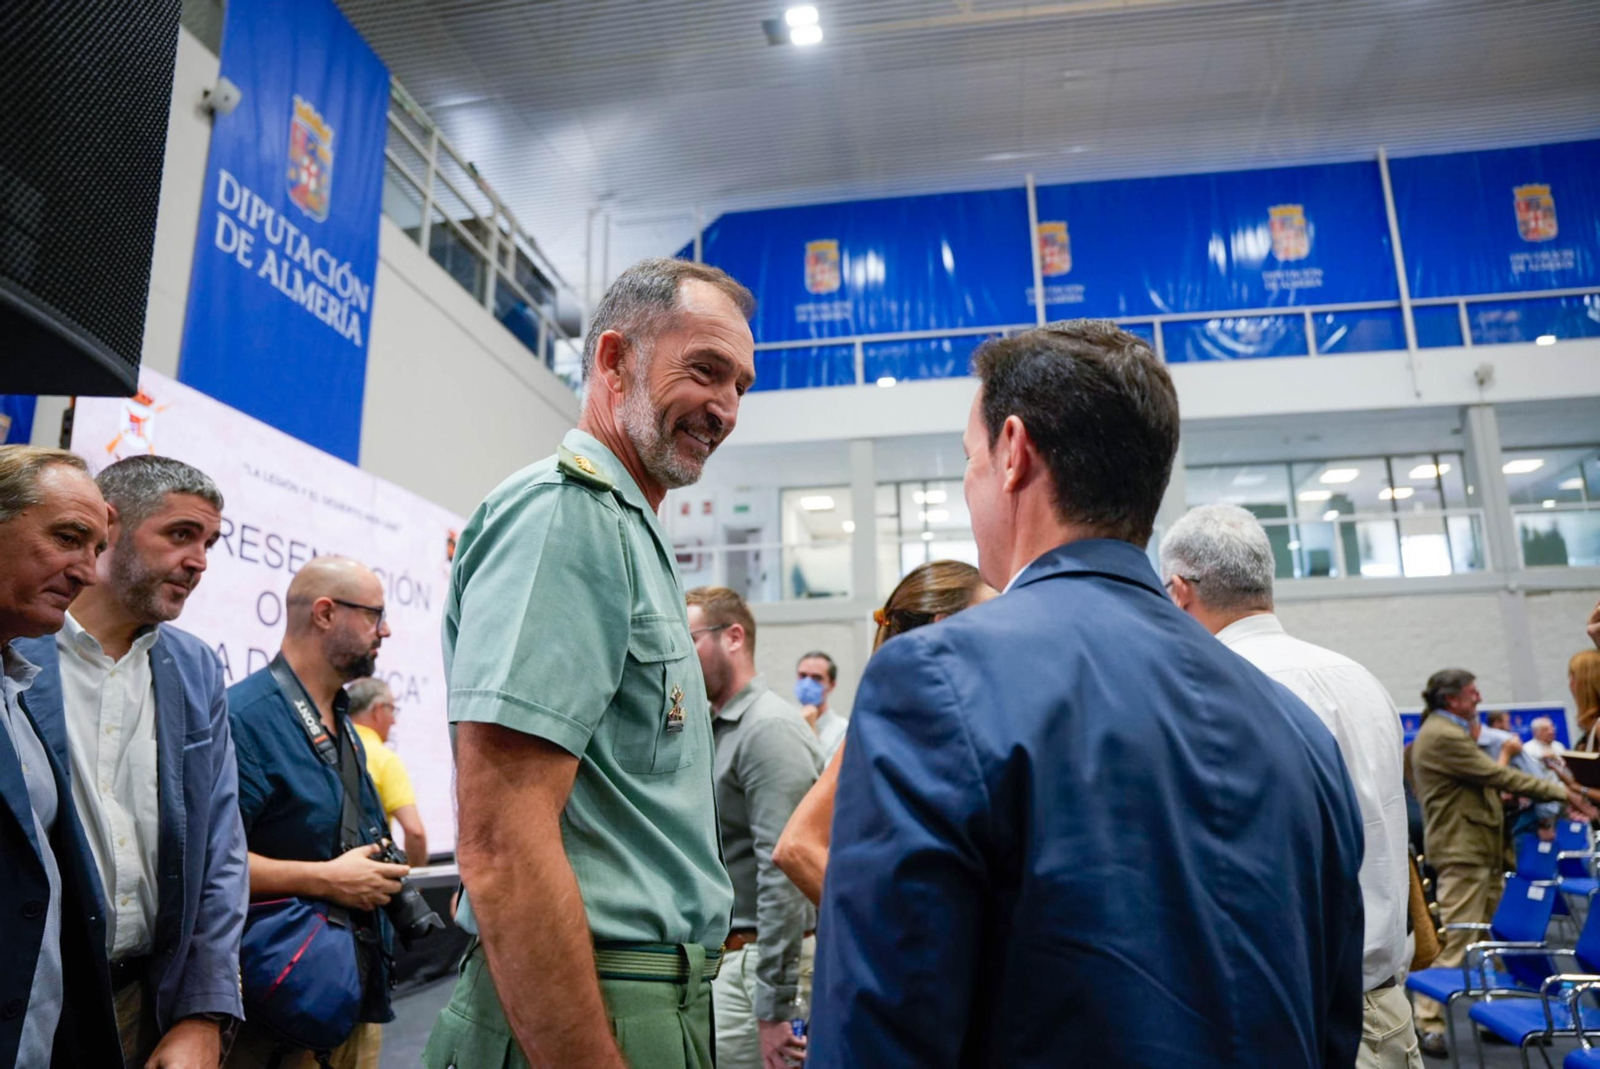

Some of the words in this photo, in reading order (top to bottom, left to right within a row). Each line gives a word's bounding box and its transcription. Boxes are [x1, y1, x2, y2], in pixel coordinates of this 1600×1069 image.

[215, 211, 255, 269] DE
[258, 248, 362, 347] ALMERÍA
[217, 168, 370, 312] DIPUTACIÓN
[294, 700, 321, 736] SONY
